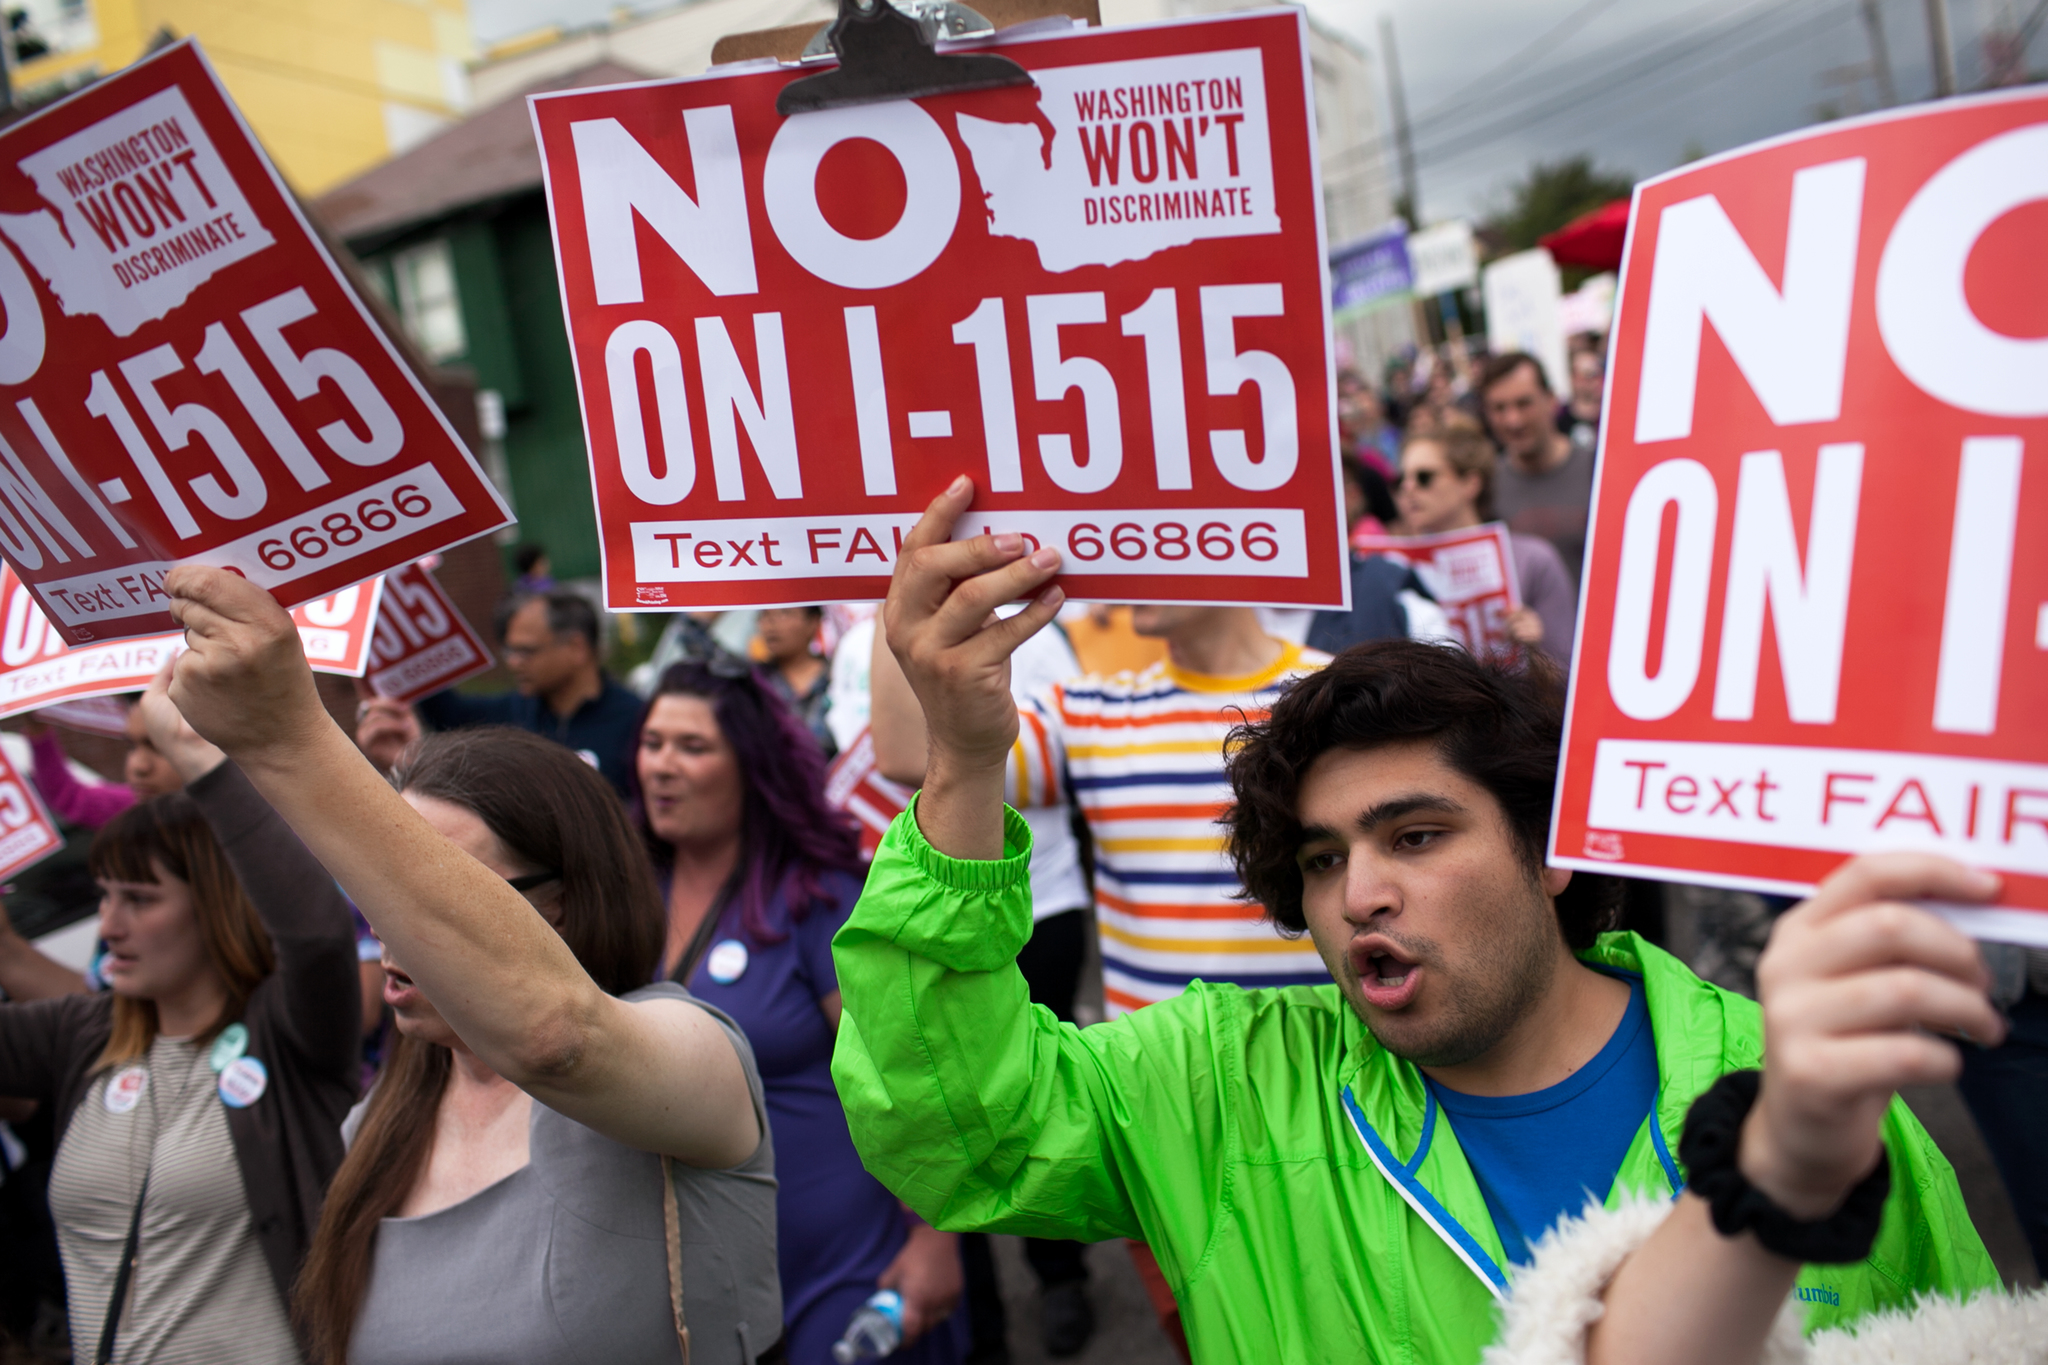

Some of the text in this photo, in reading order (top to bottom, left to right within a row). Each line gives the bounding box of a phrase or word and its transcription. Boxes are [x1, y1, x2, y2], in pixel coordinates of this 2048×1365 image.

[1074, 76, 1243, 122] WASHINGTON
[56, 116, 189, 198] WASHINGTON
[1078, 112, 1244, 187] WON'T
[75, 147, 218, 254] WON'T
[570, 98, 962, 306] NO
[1084, 186, 1253, 225] DISCRIMINATE
[112, 212, 246, 289] DISCRIMINATE
[15, 286, 404, 549] I-1515
[604, 283, 1299, 506] ON I-1515
[49, 484, 432, 615] Text FA 66866
[653, 532, 783, 568] Text
[806, 525, 916, 564] FAI
[1067, 521, 1279, 561] 66866
[1606, 435, 2048, 736] ON I
[7, 664, 68, 694] Text
[78, 648, 162, 677] FAIR
[1624, 759, 1780, 823] Text
